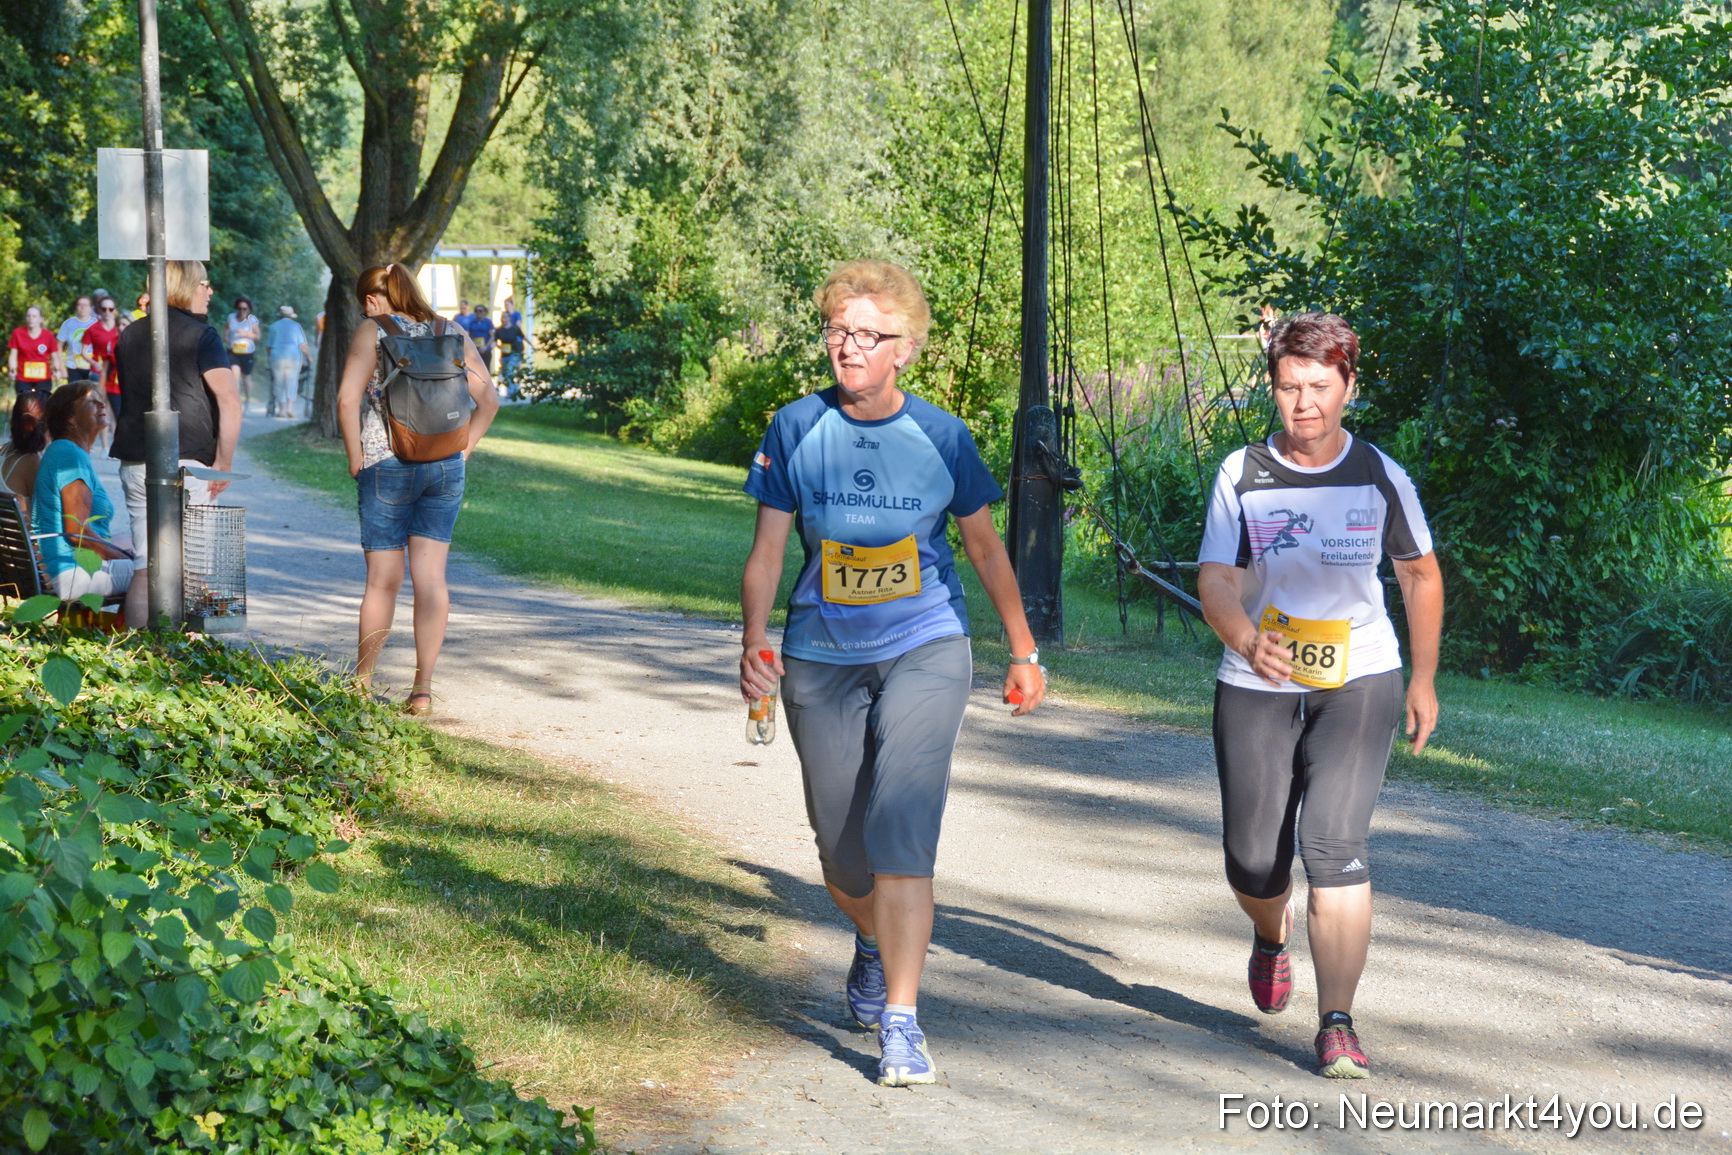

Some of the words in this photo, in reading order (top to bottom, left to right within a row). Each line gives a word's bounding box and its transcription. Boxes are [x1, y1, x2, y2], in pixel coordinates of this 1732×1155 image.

[845, 513, 876, 525] TEAM
[1321, 537, 1376, 548] VORSICHT!
[1321, 551, 1375, 561] Freilaufende
[835, 563, 907, 588] 1773
[851, 588, 877, 596] Astner
[1275, 640, 1336, 669] 468
[1302, 666, 1323, 676] Karin
